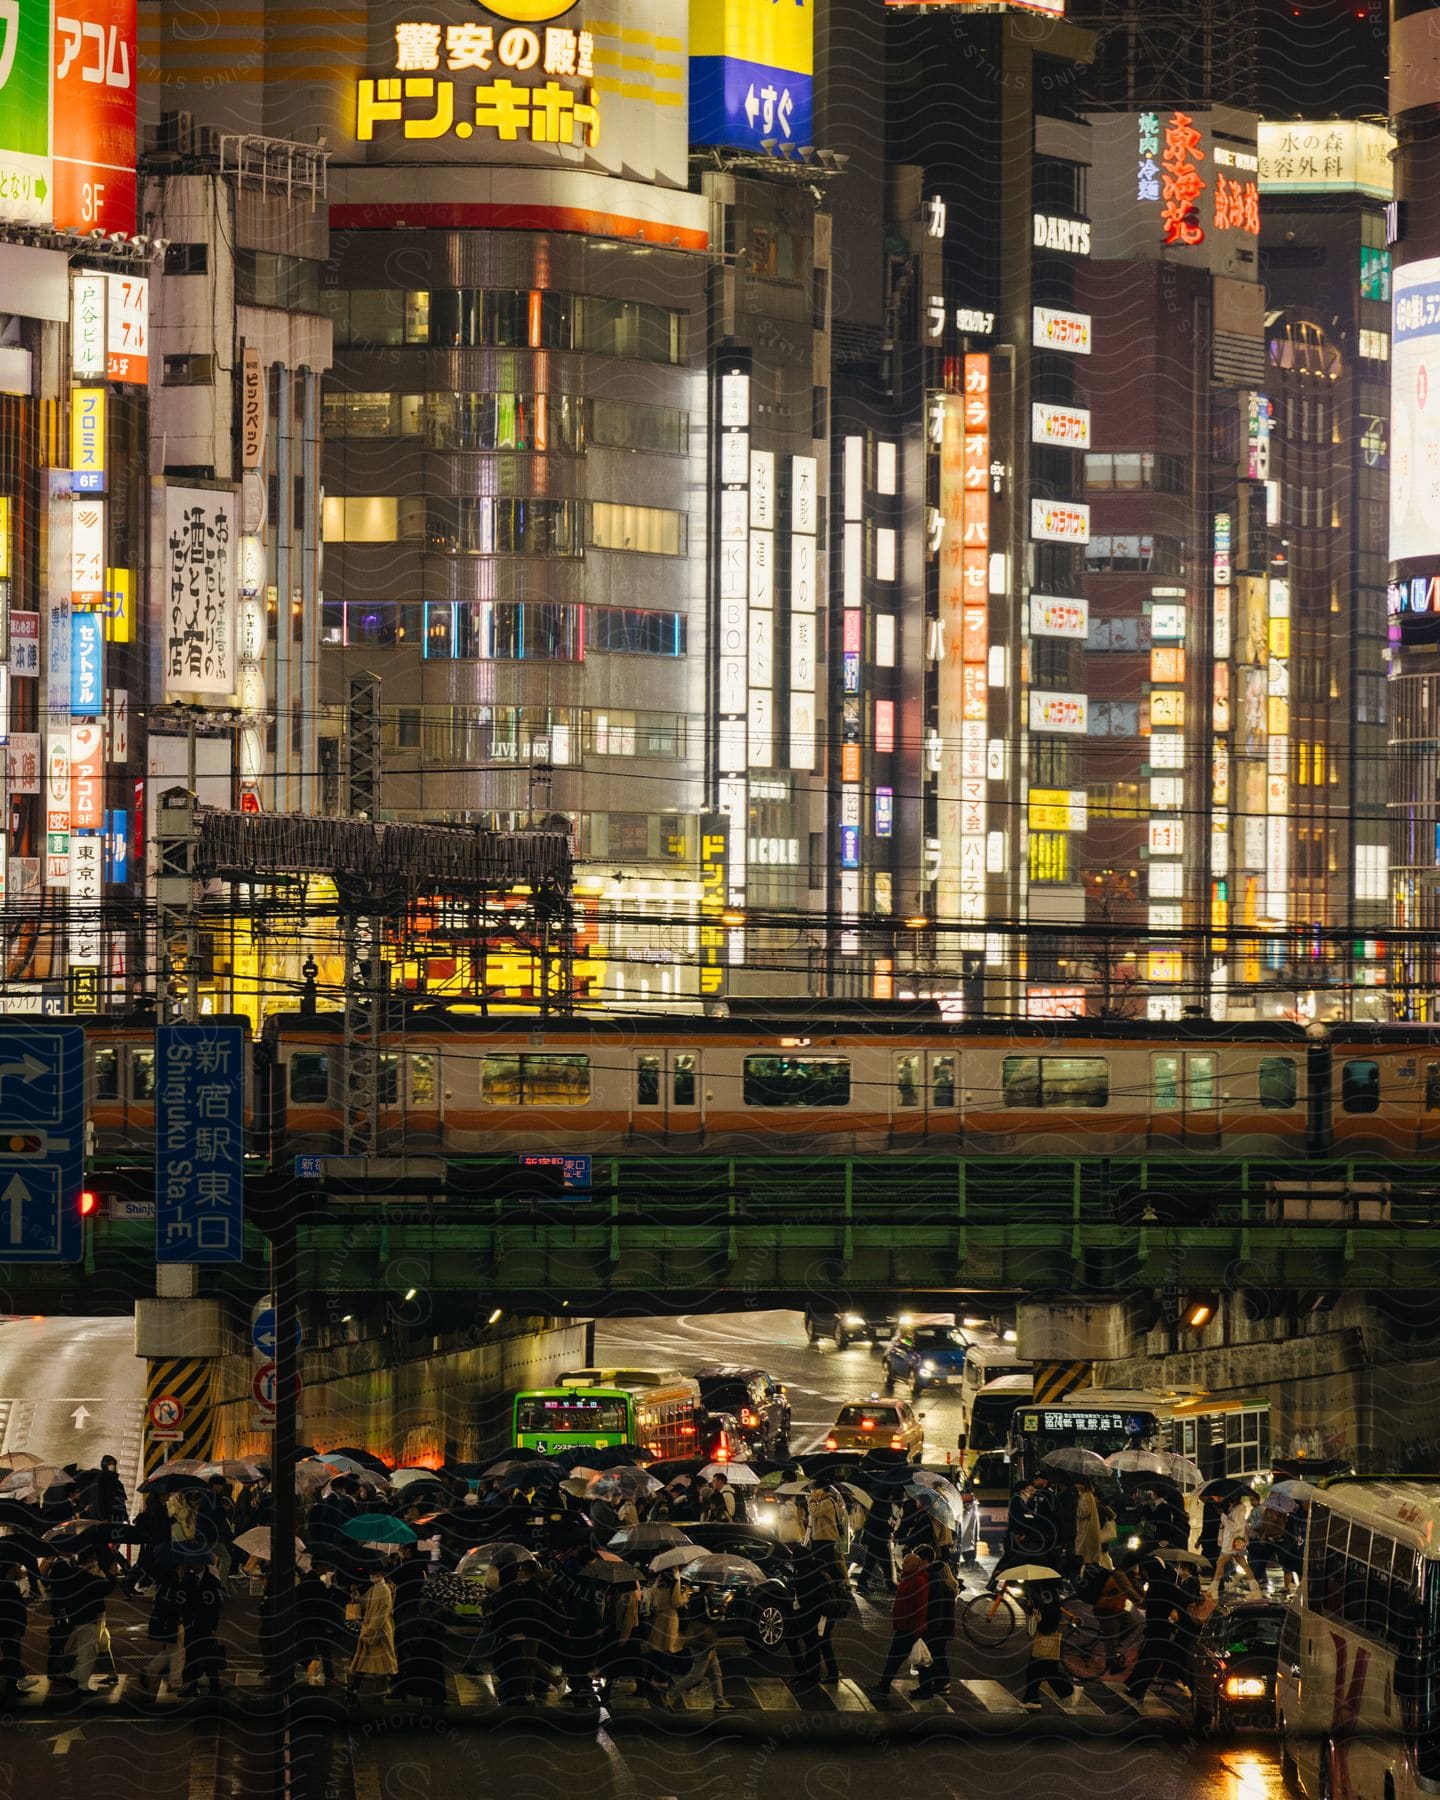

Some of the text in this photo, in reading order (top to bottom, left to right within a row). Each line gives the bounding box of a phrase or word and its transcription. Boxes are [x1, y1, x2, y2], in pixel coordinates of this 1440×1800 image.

[56, 16, 130, 89] アコム
[395, 23, 594, 79] 驚安の殿堂
[760, 85, 794, 138] すぐ
[1280, 132, 1342, 153] 水の森
[81, 183, 105, 222] 3F
[1034, 213, 1091, 254] DARTS
[79, 285, 99, 364] 戸谷ビル
[83, 371, 94, 379] 7F
[81, 396, 97, 464] プロミス
[80, 475, 98, 488] 6F
[81, 593, 94, 603] 5F
[727, 547, 743, 707] KIBORI
[79, 625, 94, 704] セントラル
[491, 742, 517, 757] LIVE
[77, 765, 93, 811] アコム
[966, 784, 981, 830] ママ会
[78, 815, 92, 825] 3F
[162, 1045, 192, 1150] Shinjuku
[195, 1040, 231, 1248] 新宿駅東口
